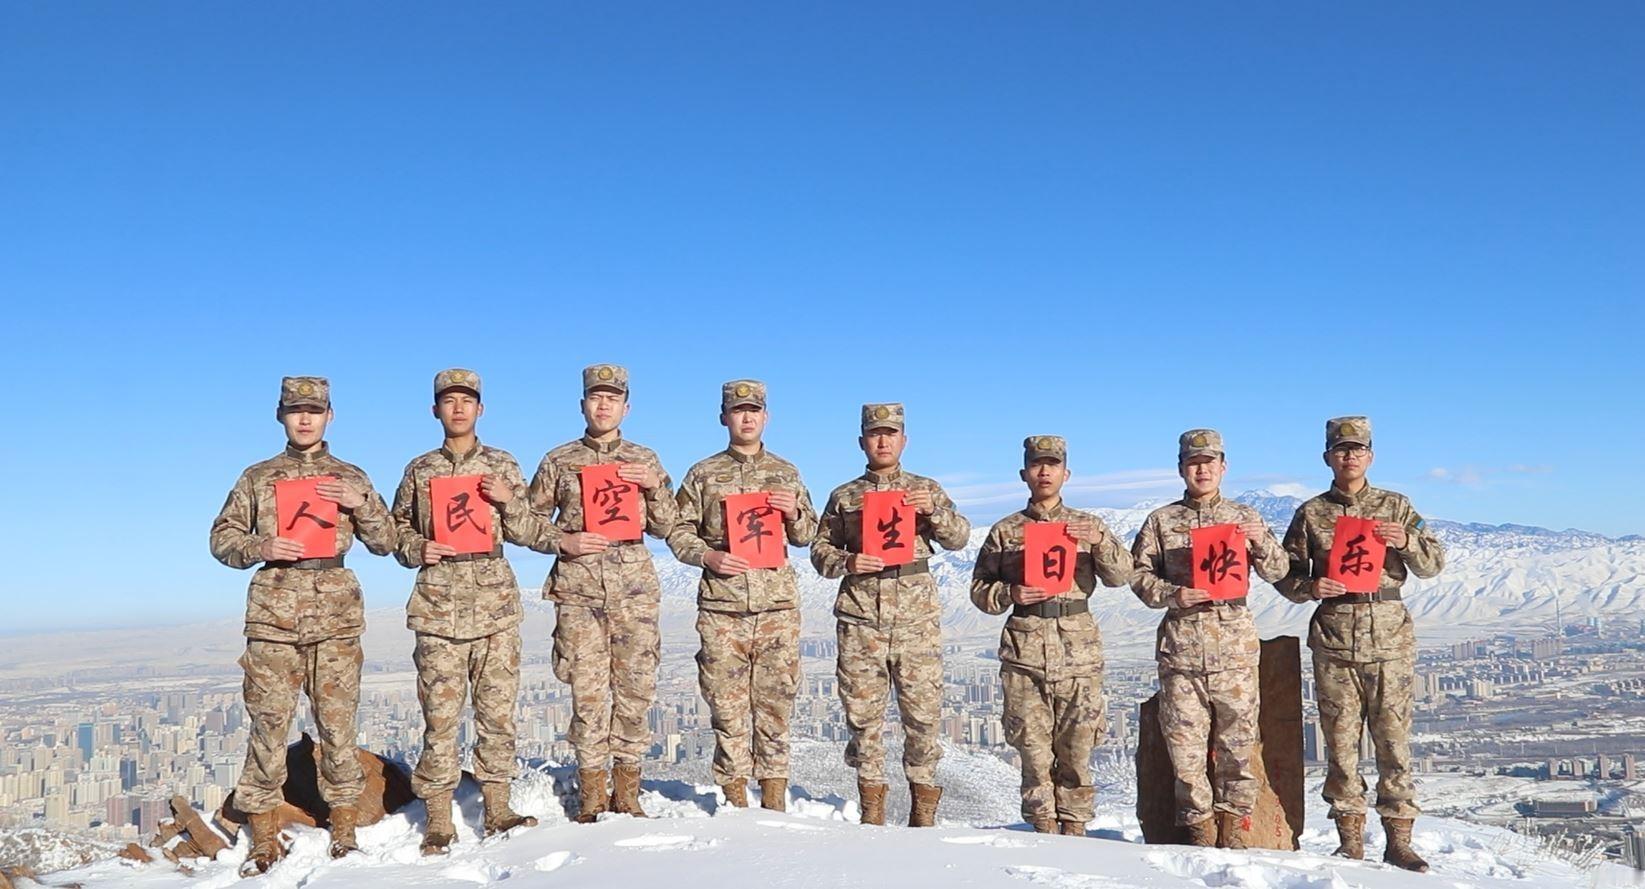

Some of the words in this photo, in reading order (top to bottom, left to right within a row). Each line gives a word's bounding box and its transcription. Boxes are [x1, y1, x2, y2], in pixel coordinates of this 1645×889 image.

[286, 501, 335, 530] 人
[447, 491, 486, 534] 民
[593, 480, 630, 524] 空
[737, 506, 774, 553] 军
[878, 507, 904, 550] 生
[1043, 545, 1067, 582] 日
[1200, 541, 1241, 584] 快
[1340, 535, 1373, 576] 乐
